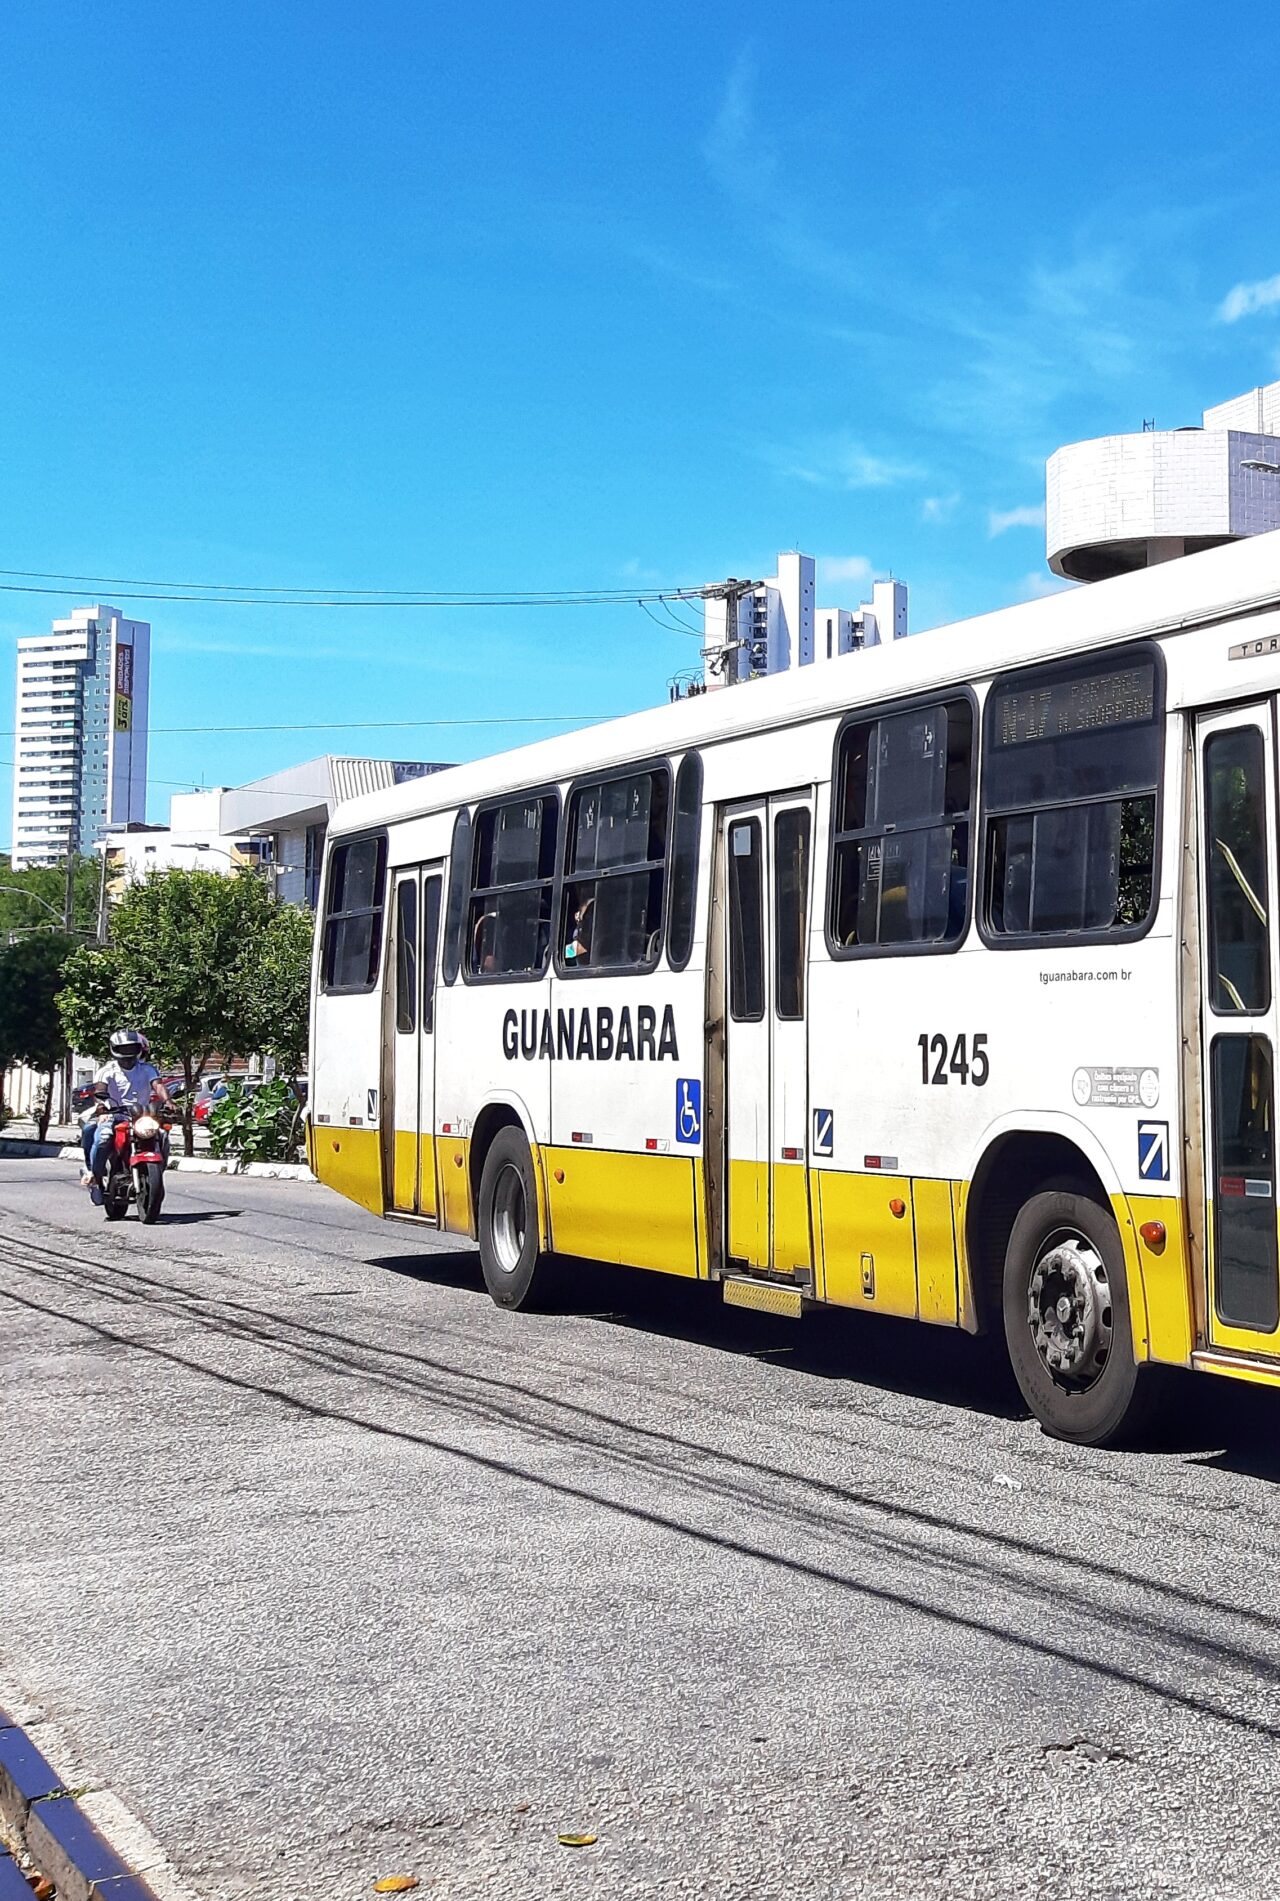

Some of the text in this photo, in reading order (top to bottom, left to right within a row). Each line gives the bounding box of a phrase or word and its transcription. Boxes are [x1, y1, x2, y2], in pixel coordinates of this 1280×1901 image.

[1121, 968, 1132, 980] br
[502, 1004, 680, 1061] GUANABARA
[917, 1033, 990, 1087] 1245
